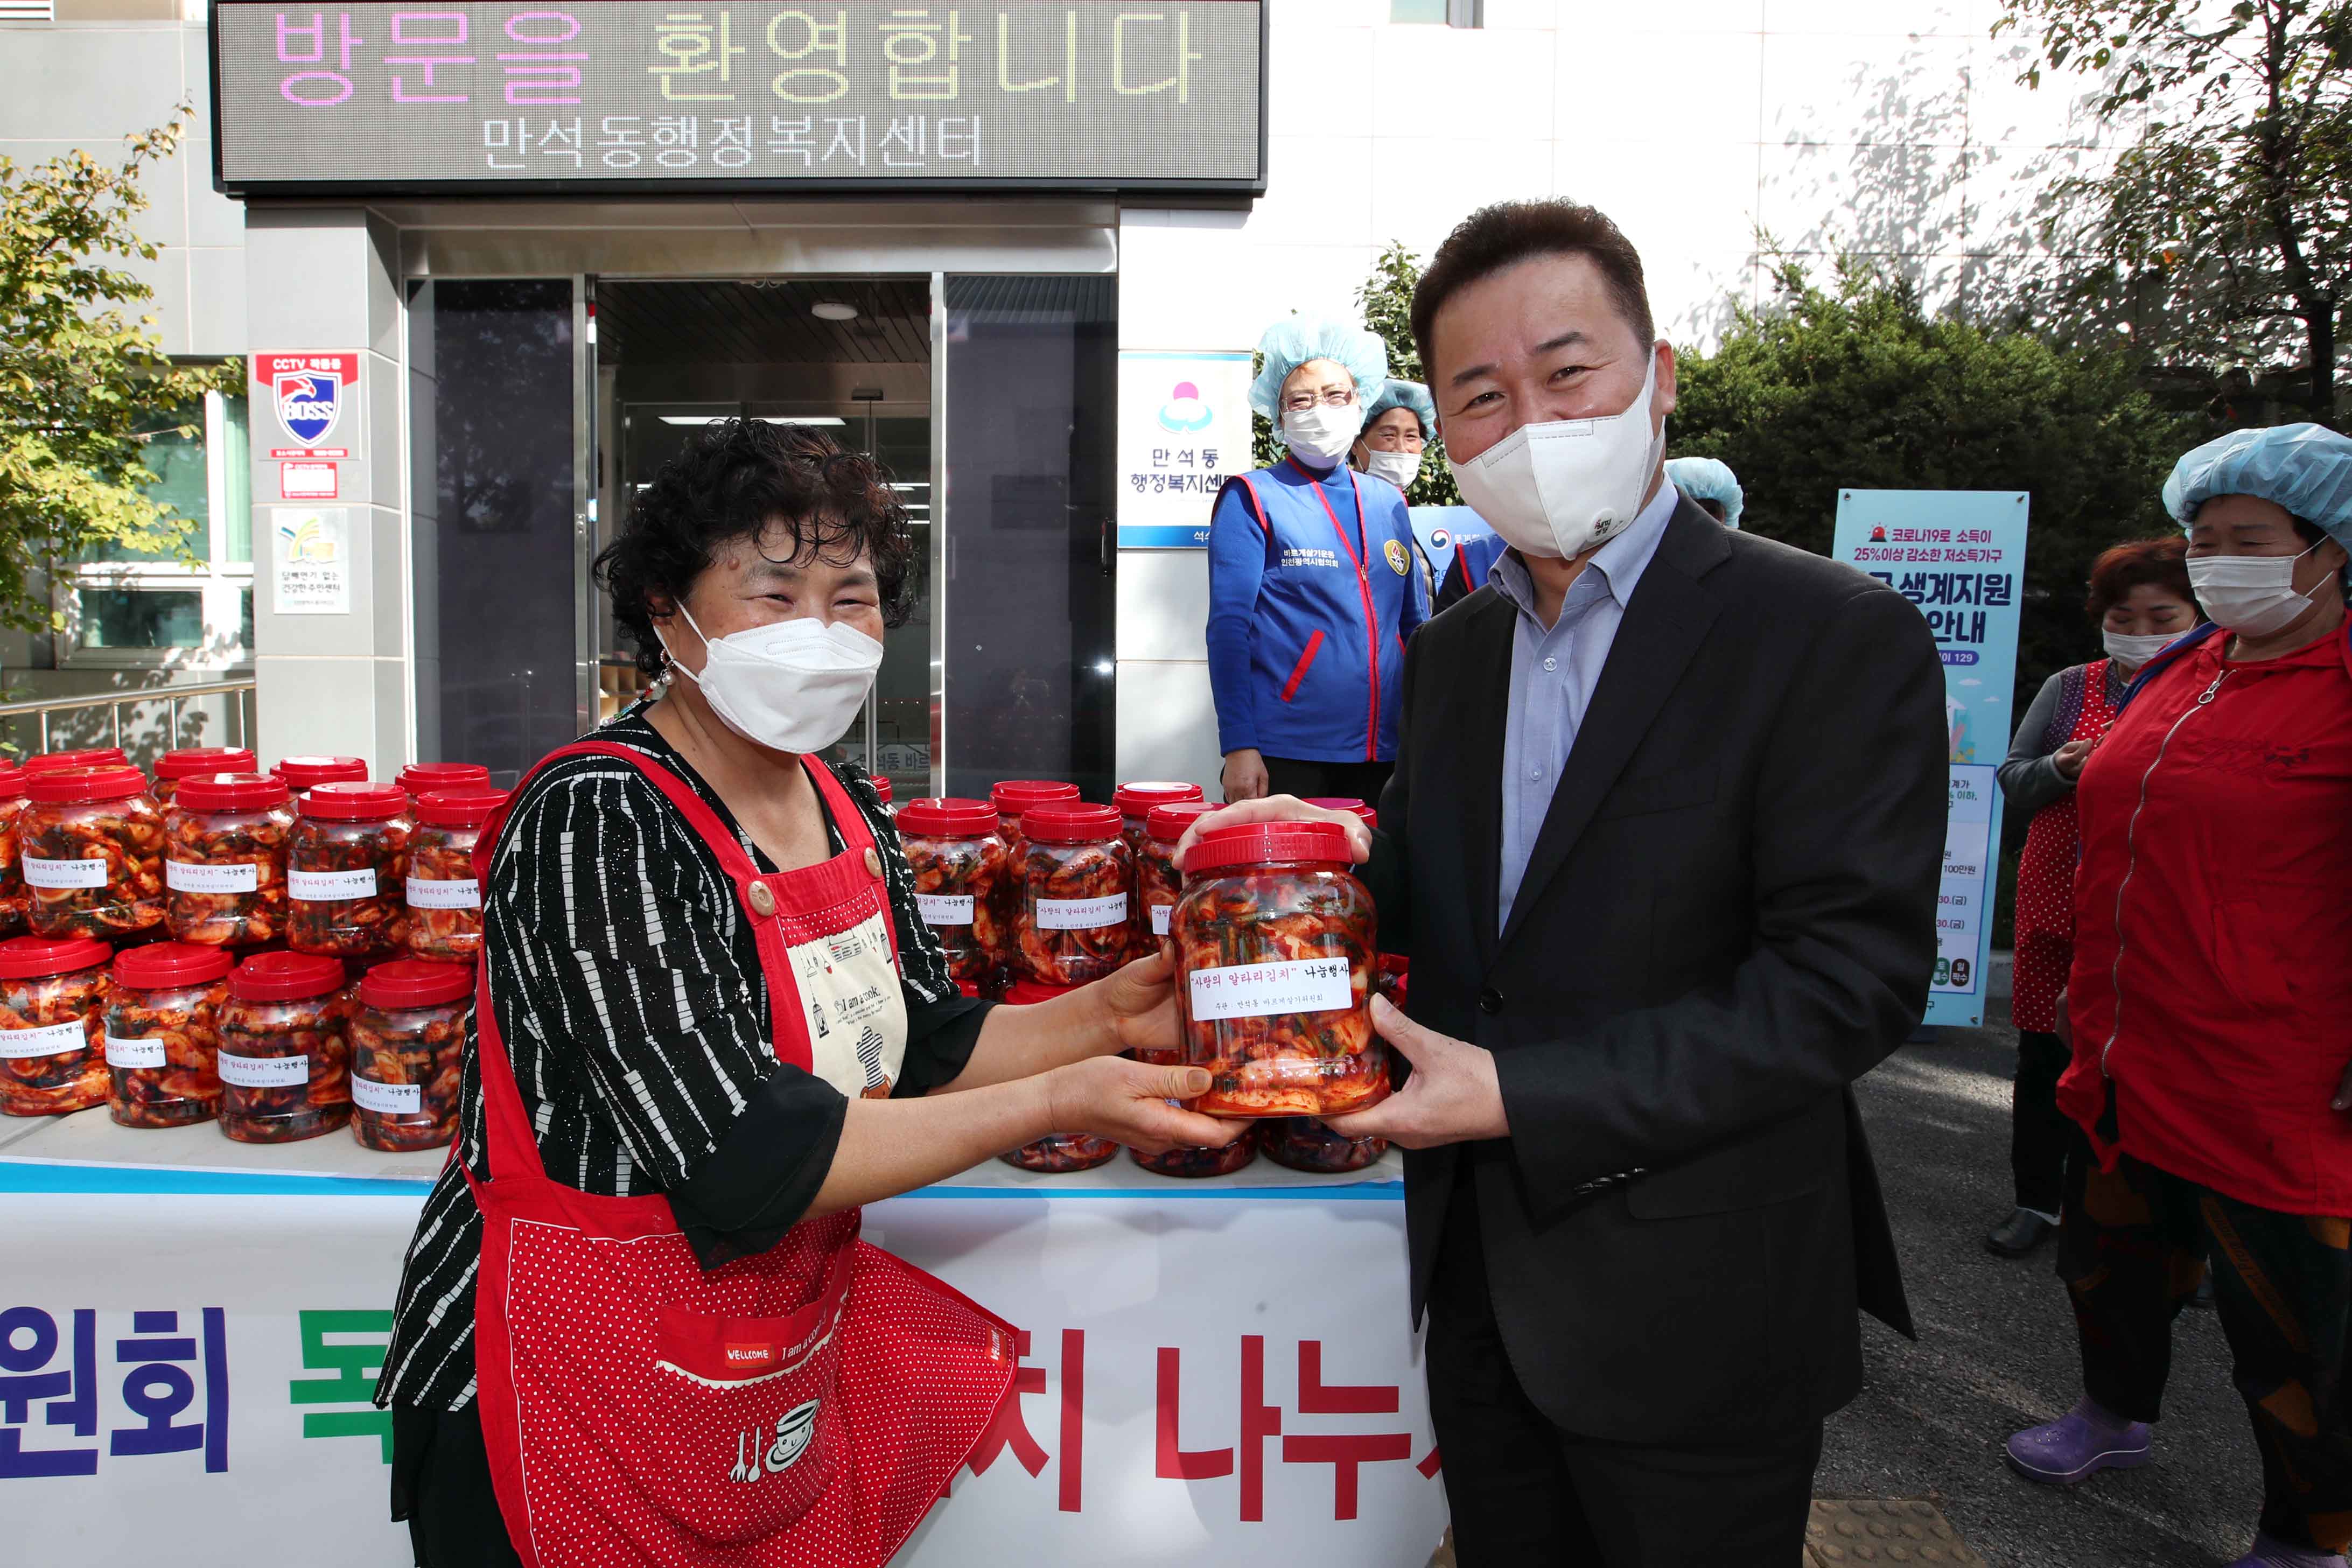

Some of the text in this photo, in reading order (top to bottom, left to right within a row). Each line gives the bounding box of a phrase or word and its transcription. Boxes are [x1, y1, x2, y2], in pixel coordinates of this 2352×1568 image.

[275, 9, 1202, 106] 방문을 환영합니다
[272, 358, 306, 370] CCTV
[284, 401, 334, 421] BOSS
[1130, 473, 1234, 494] 행정복지센
[1891, 528, 1992, 543] 코로나19로 소득이
[1283, 548, 1335, 559] 바르게살기운동
[1853, 548, 2003, 563] 25%이상 감소한 저소득가구
[1899, 572, 2012, 606] 생계지원
[1926, 610, 1986, 643] 안내
[1954, 653, 1973, 663] 129
[944, 898, 973, 907] 나눔행사
[1304, 963, 1349, 979] 나눔행사
[848, 996, 859, 1009] am
[1236, 999, 1259, 1009] 만석동
[727, 1349, 769, 1361] WELLCOME
[781, 1347, 787, 1361] I
[788, 1343, 802, 1358] am
[802, 1339, 808, 1349] a
[940, 1329, 1084, 1513] 치
[1156, 1335, 1441, 1522] 나누
